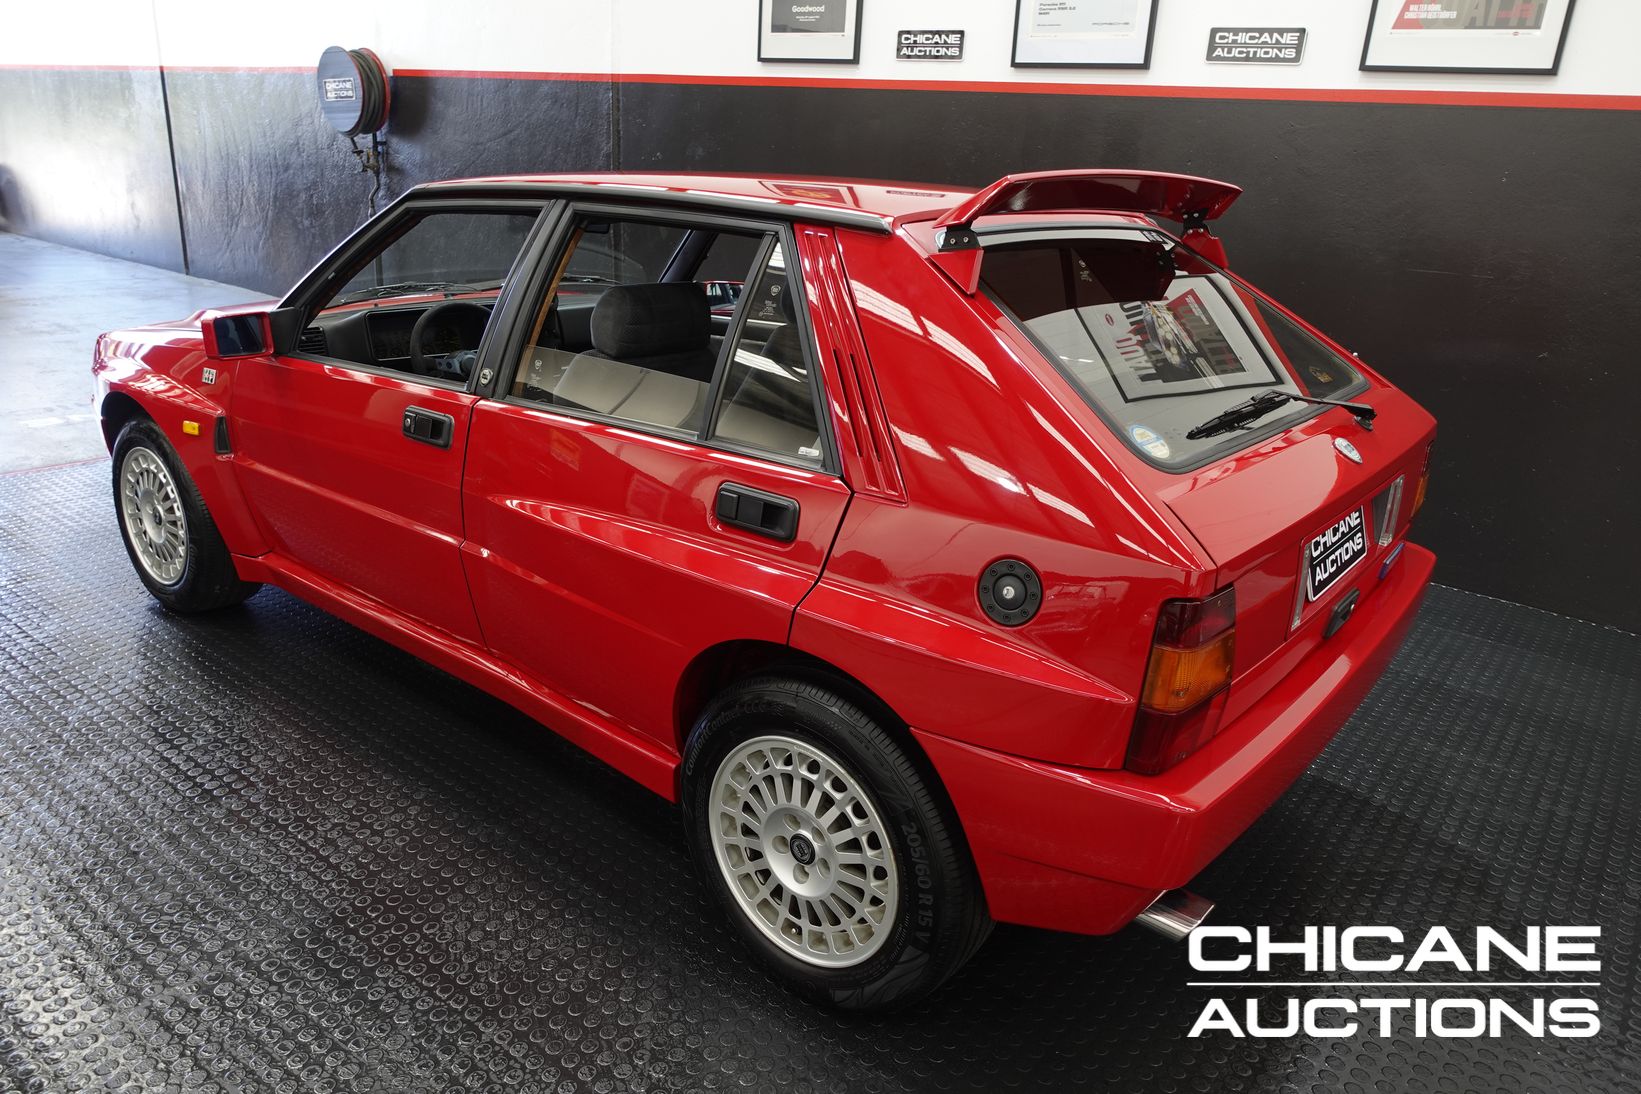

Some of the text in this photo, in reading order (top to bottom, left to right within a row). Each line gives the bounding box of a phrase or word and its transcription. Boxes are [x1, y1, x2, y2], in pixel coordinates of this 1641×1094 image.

[791, 5, 825, 13] Goodwood
[901, 34, 961, 44] CHICANE
[1215, 32, 1300, 44] CHICANE
[900, 47, 960, 56] AUCTIONS
[1212, 47, 1297, 58] AUCTIONS
[1311, 511, 1361, 558] CHICANE
[1314, 532, 1363, 586] AUCTIONS
[901, 821, 932, 889] 205/60
[918, 893, 934, 905] R
